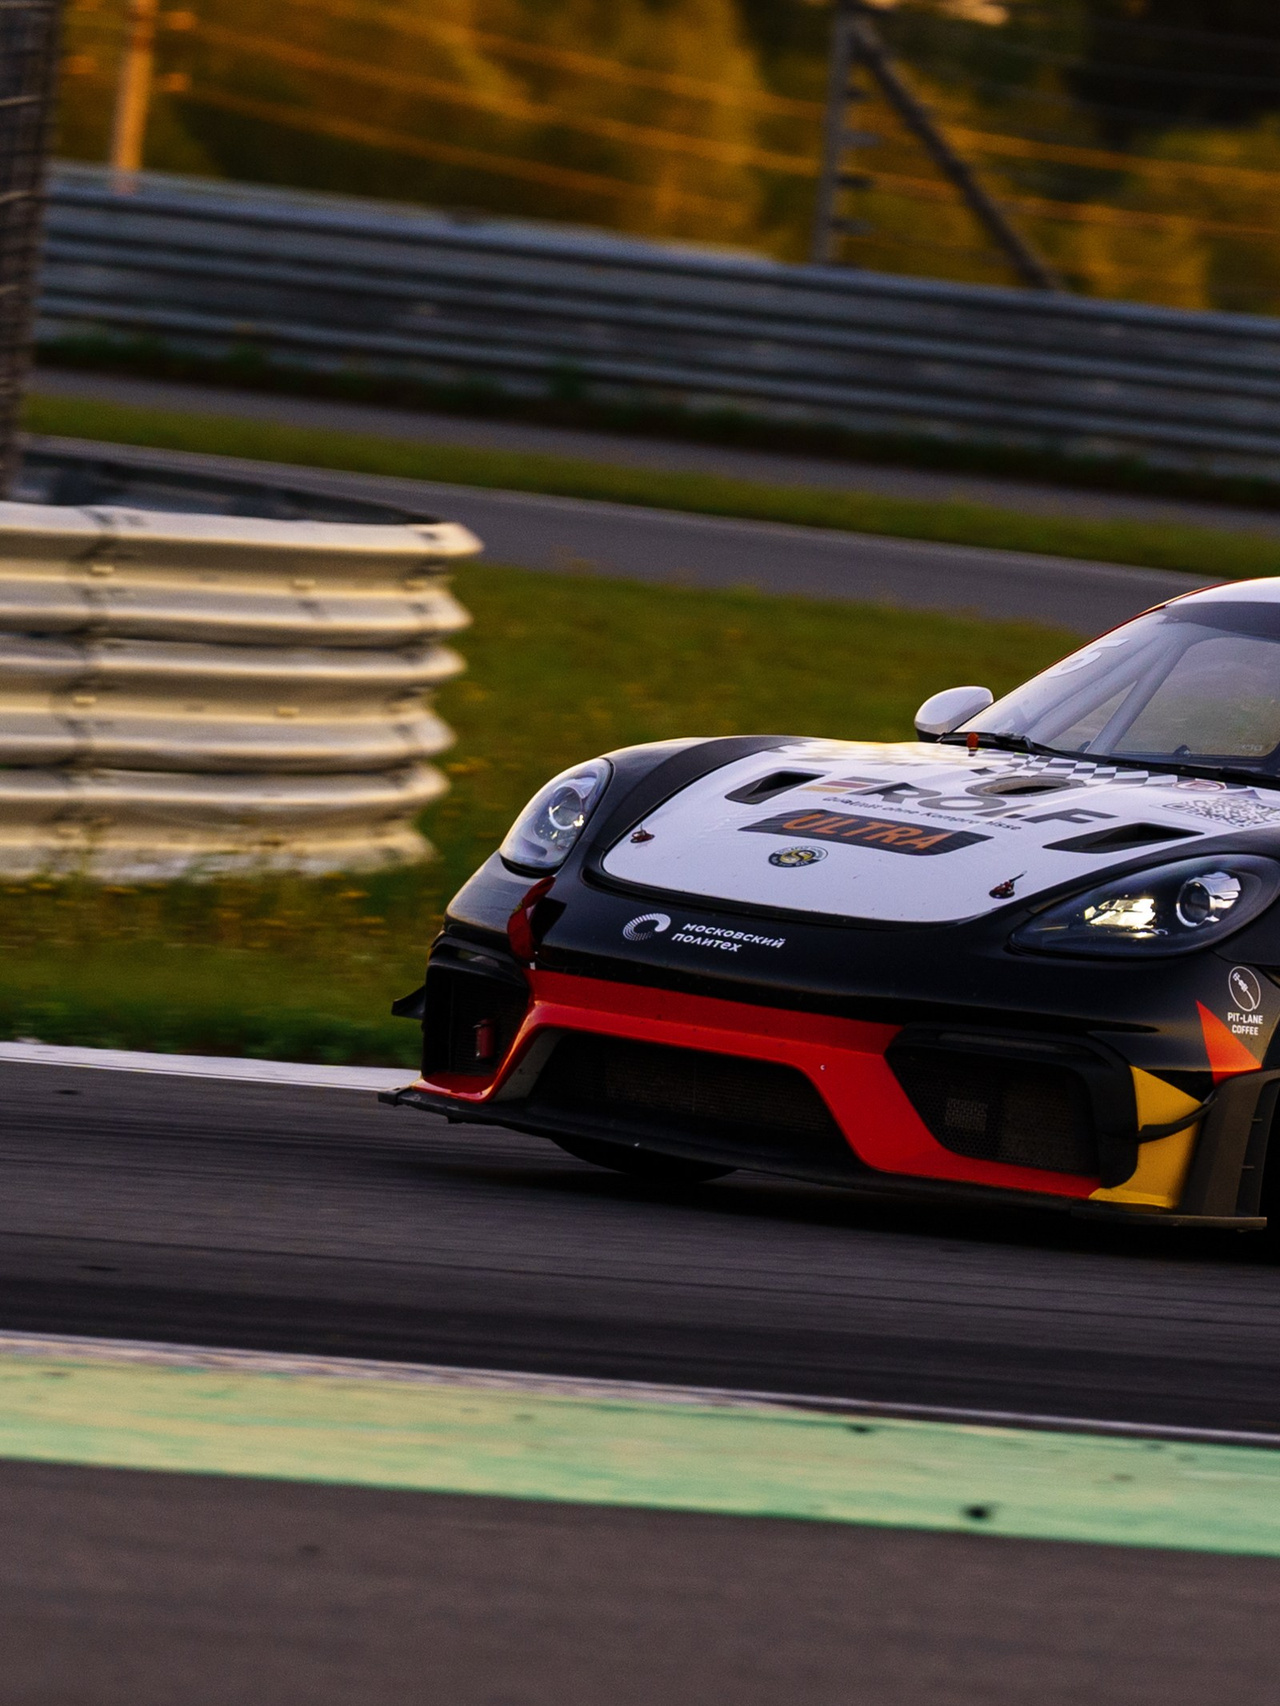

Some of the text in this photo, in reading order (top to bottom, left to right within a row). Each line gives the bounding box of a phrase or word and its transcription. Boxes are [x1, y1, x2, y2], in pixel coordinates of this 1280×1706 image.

[782, 812, 953, 850] ULTRA
[1227, 1011, 1264, 1025] PIT-LANE
[1231, 1024, 1259, 1036] COFFEE
